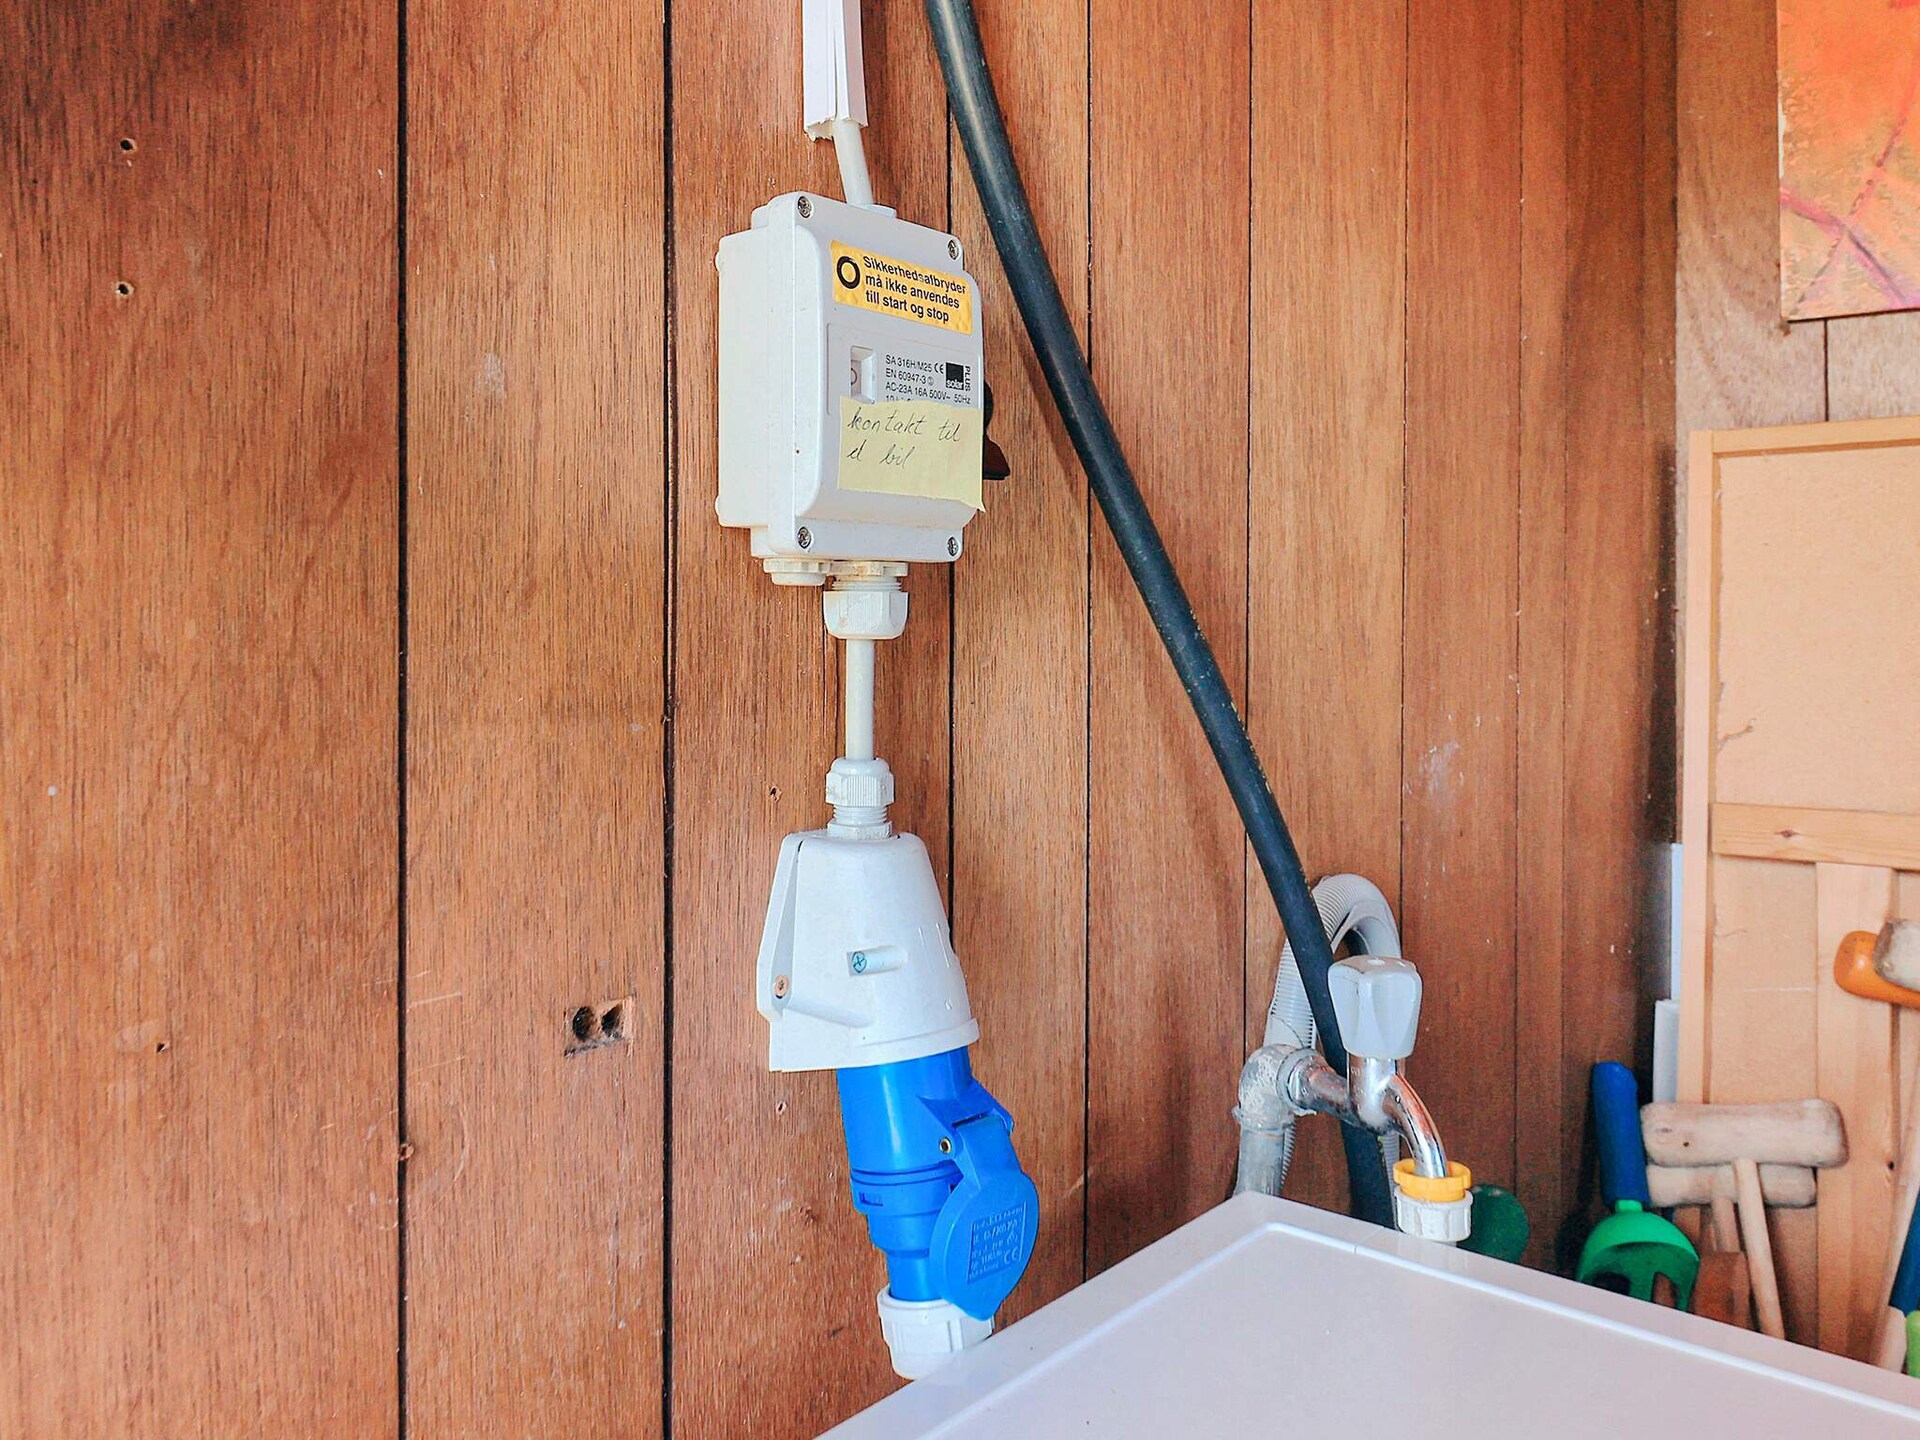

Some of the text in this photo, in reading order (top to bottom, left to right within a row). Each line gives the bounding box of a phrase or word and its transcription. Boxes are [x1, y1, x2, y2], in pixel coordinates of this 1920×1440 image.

[865, 274, 960, 309] må ikke anvendes
[866, 290, 949, 324] till start og stop
[885, 368, 897, 378] EN
[914, 387, 928, 397] 16A
[847, 406, 961, 442] kontakt til
[879, 444, 915, 469] bil
